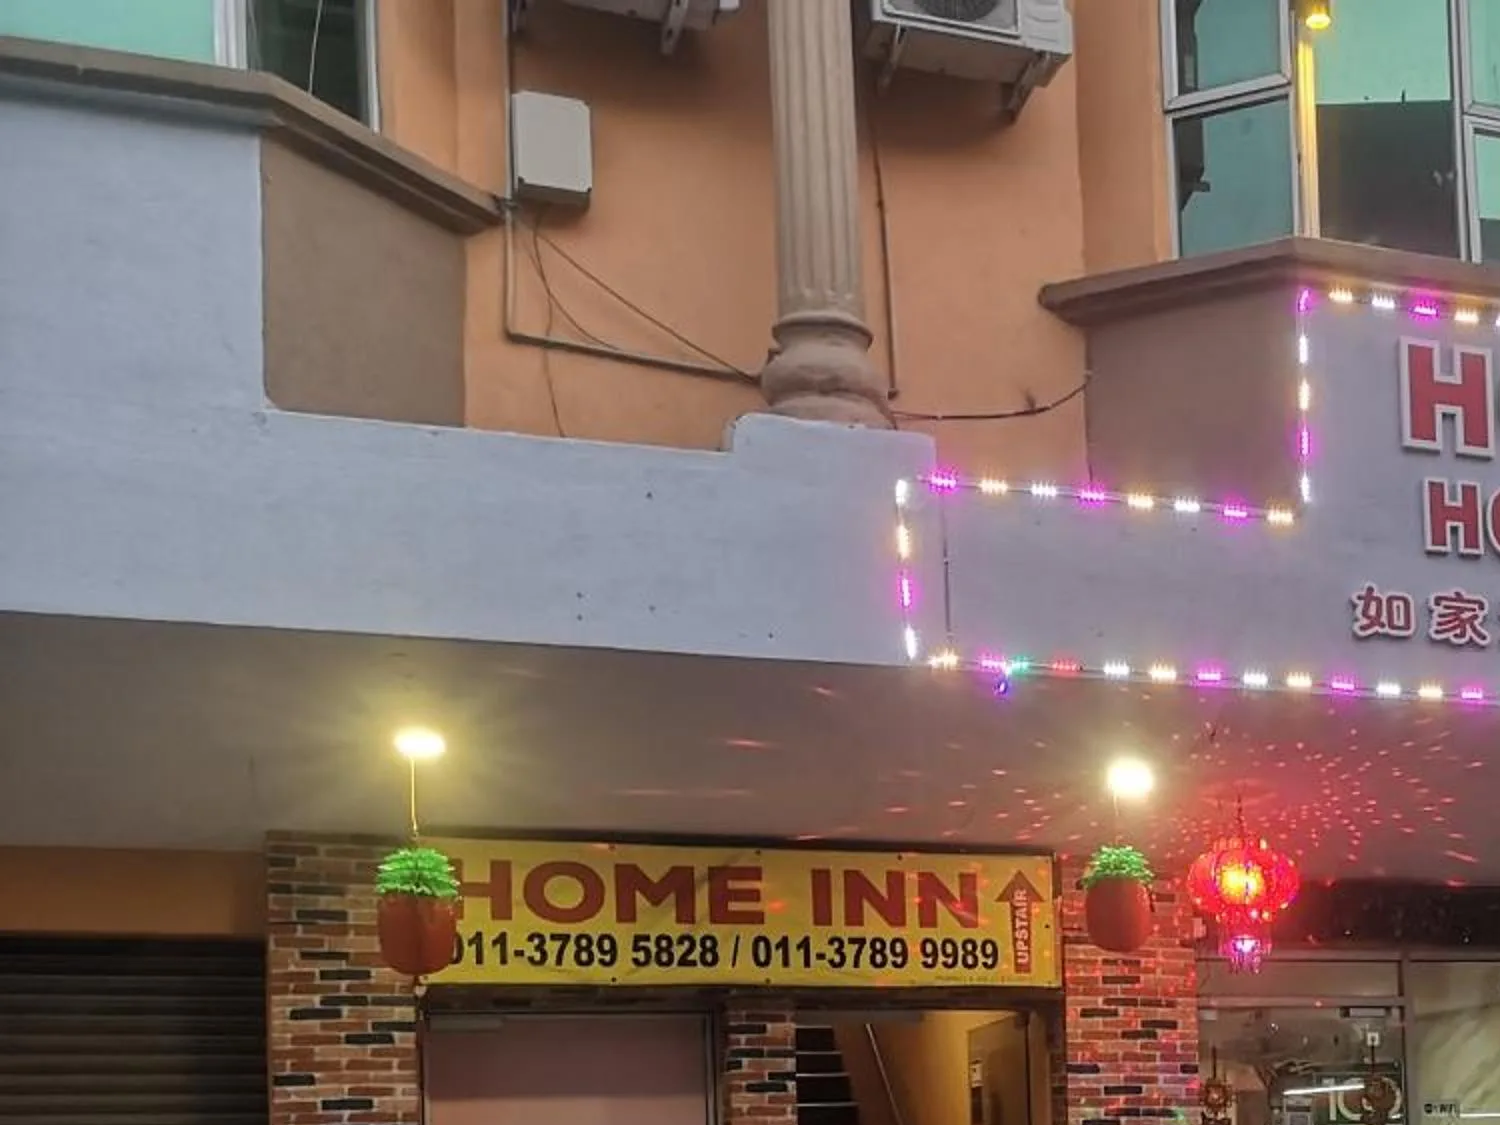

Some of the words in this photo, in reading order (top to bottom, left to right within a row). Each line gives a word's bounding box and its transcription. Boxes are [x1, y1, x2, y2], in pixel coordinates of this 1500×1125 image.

[449, 858, 765, 925] HOME
[811, 869, 979, 929] INN
[1013, 888, 1030, 965] UPSTAIR
[452, 931, 618, 968] 011-3789
[631, 933, 720, 968] 5828
[731, 935, 741, 969] /
[752, 935, 909, 969] 011-3789
[919, 937, 999, 969] 9989
